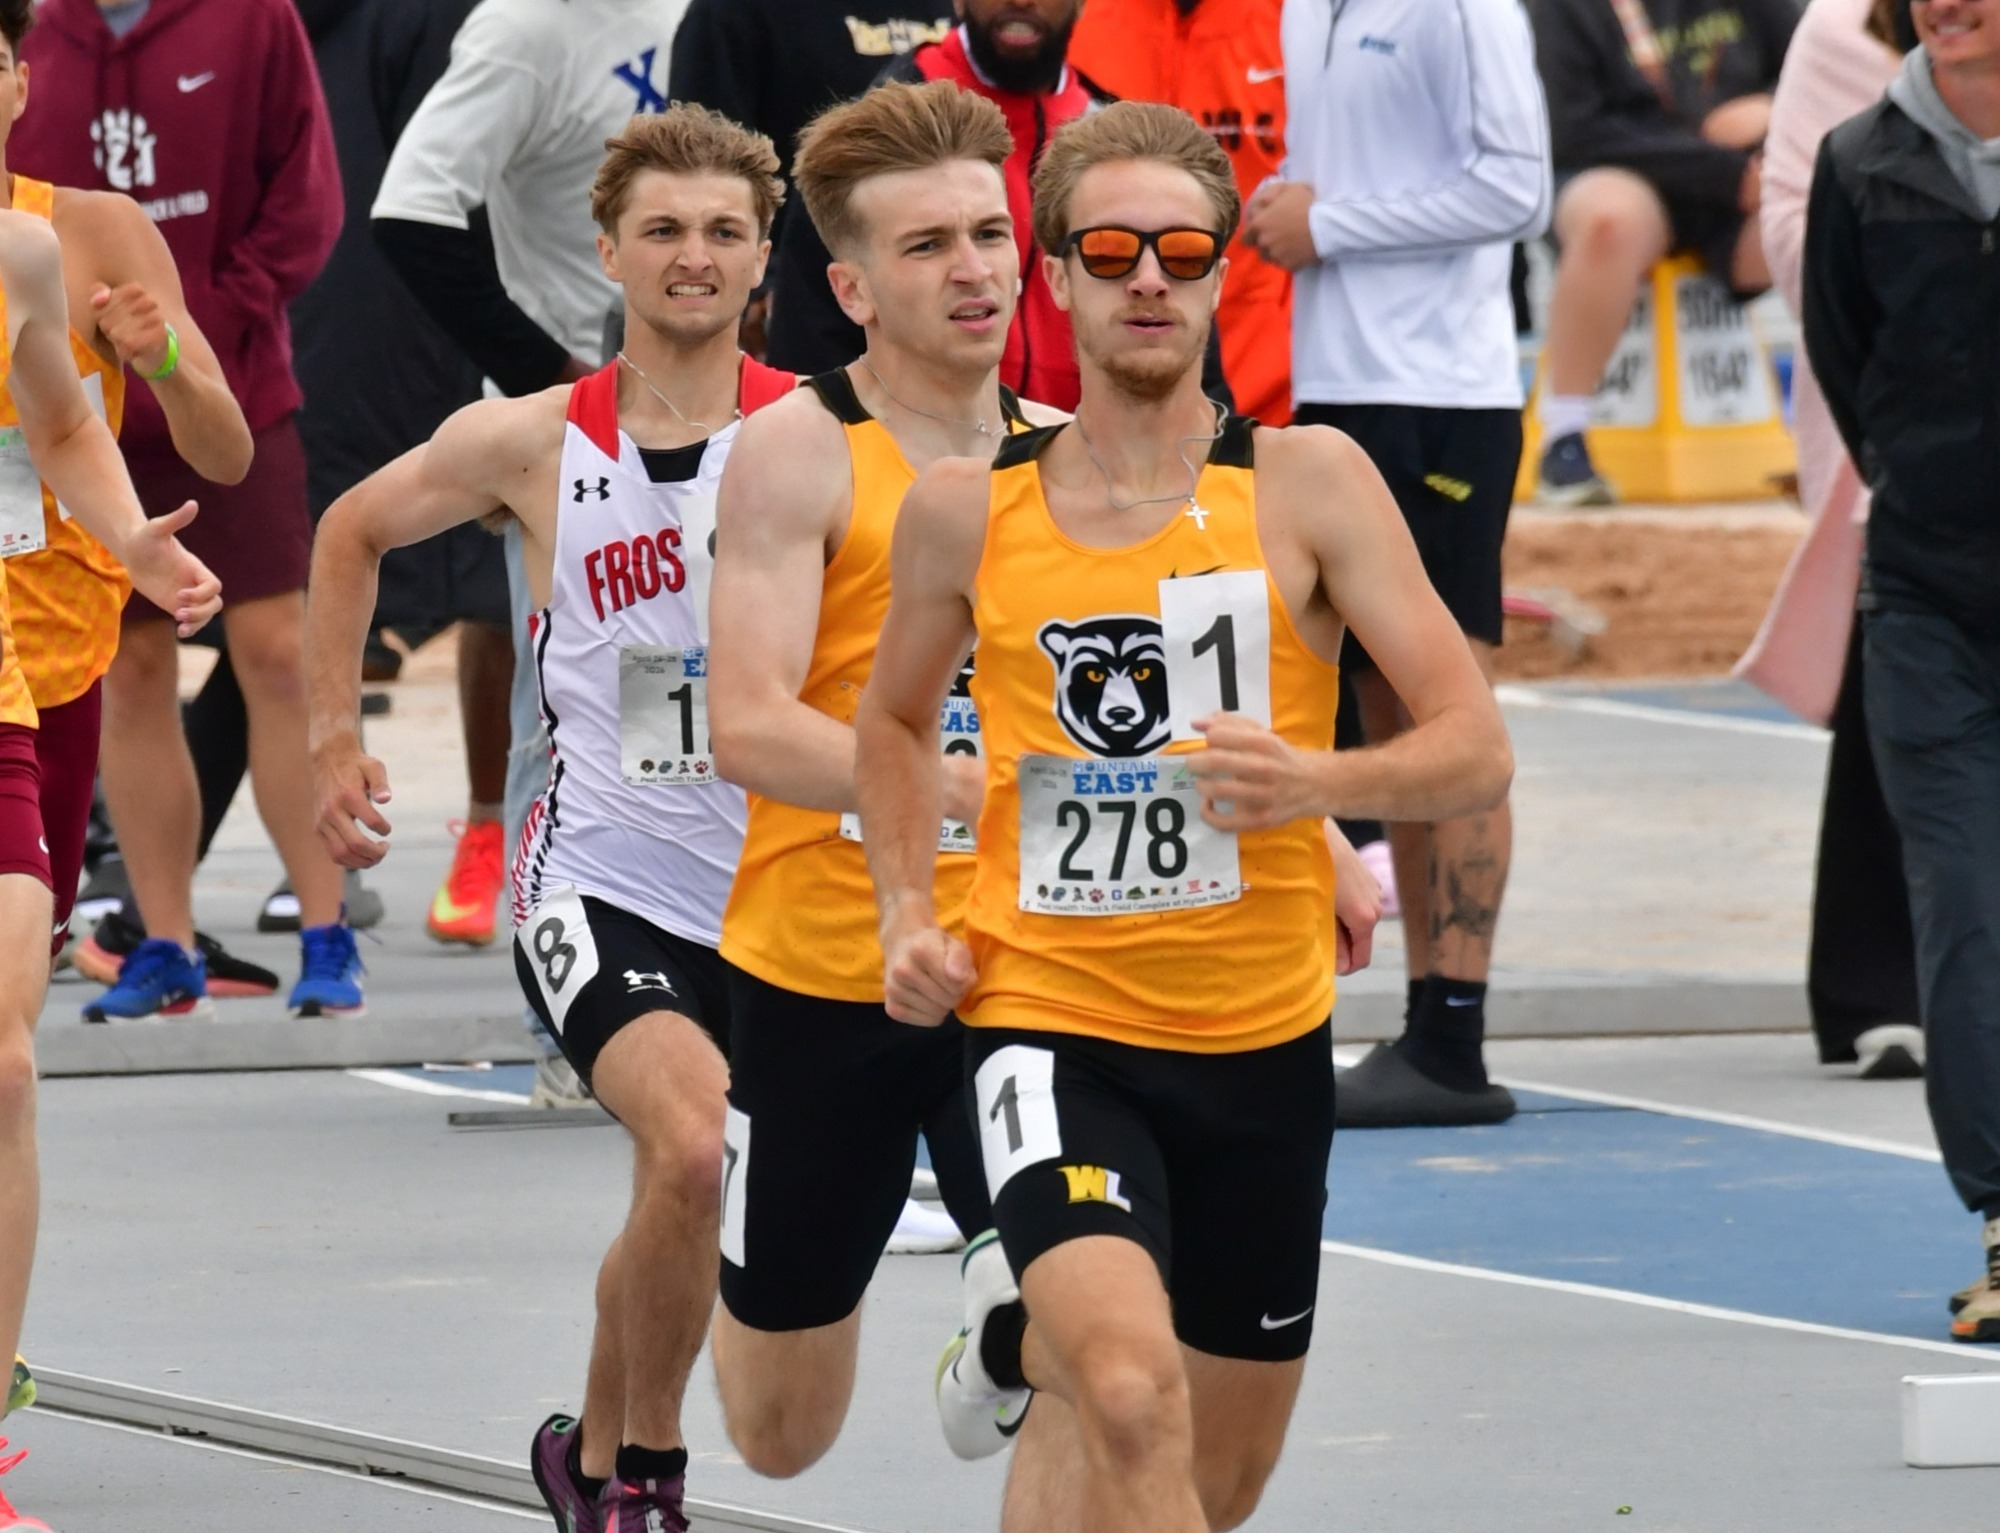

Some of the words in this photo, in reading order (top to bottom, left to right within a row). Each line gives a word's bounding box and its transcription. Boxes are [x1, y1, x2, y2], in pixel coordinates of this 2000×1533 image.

[612, 47, 666, 113] X
[585, 525, 686, 624] FROS
[1192, 614, 1239, 711] 1
[668, 683, 713, 754] 1
[1072, 760, 1157, 772] MOUNTAIN
[1072, 771, 1158, 795] EAST
[1056, 798, 1188, 881] 278
[533, 917, 577, 994] 8
[990, 1074, 1024, 1156] 1
[1056, 1164, 1132, 1213] WL
